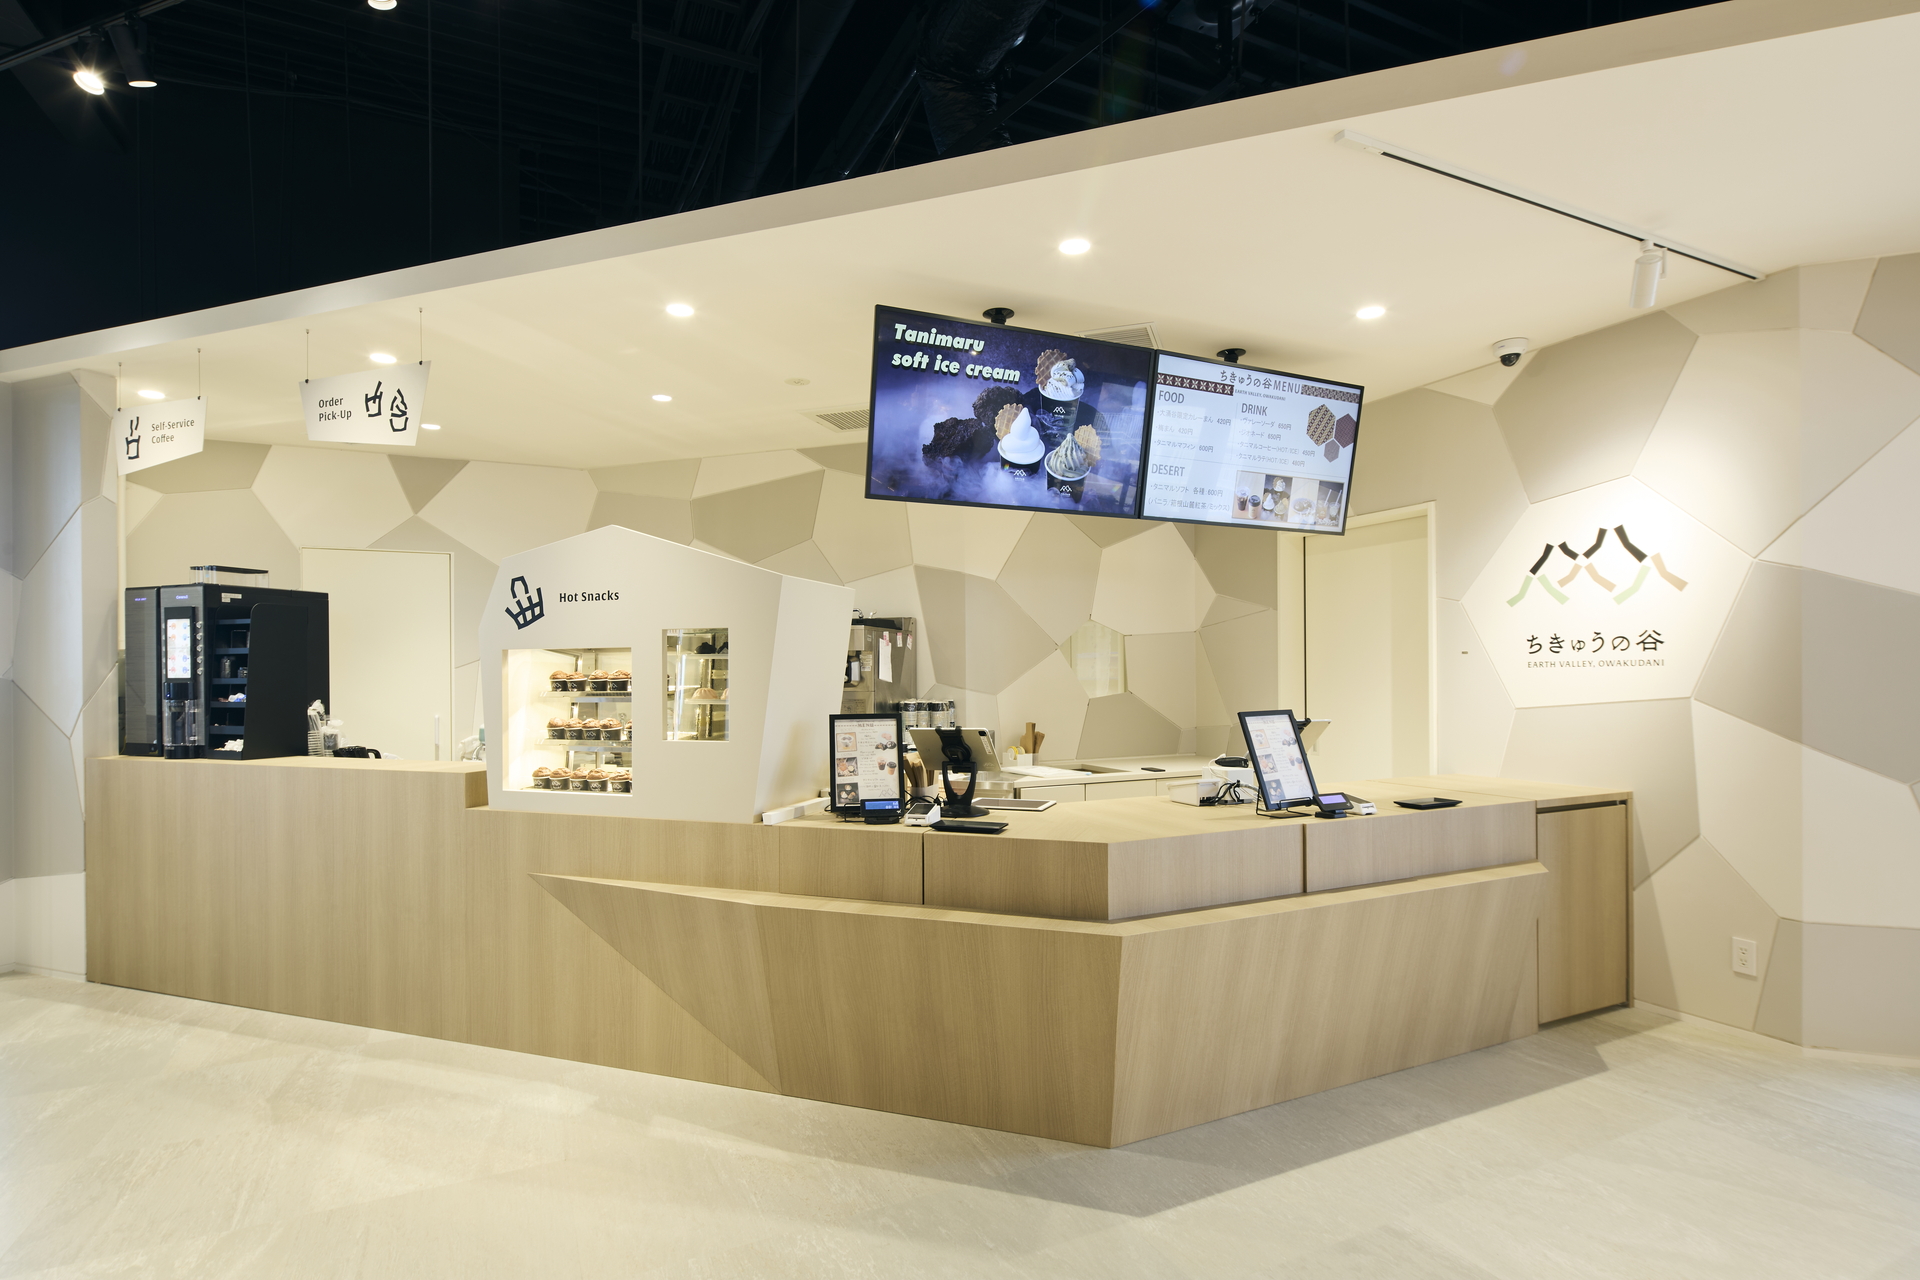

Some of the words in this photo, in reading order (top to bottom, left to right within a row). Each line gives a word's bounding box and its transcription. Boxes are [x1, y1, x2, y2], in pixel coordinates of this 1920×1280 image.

[894, 323, 985, 353] Tanimaru
[891, 352, 929, 370] soft
[933, 355, 960, 375] ice
[965, 362, 1021, 383] cream
[318, 396, 343, 410] Order
[1158, 390, 1184, 404] FOOD
[318, 408, 353, 423] Pick-Up
[1241, 403, 1268, 417] DRINK
[151, 417, 195, 432] Self-Service
[151, 432, 175, 445] Coffee
[1198, 445, 1213, 453] 600円
[1151, 463, 1185, 477] DESERT
[559, 592, 579, 603] Hot
[581, 591, 620, 602] Snacks
[1526, 630, 1665, 655] ちきゅうの谷
[1527, 661, 1556, 669] EARTH
[1559, 660, 1595, 669] VALLEY,
[1598, 659, 1665, 668] OWAKUDANI
